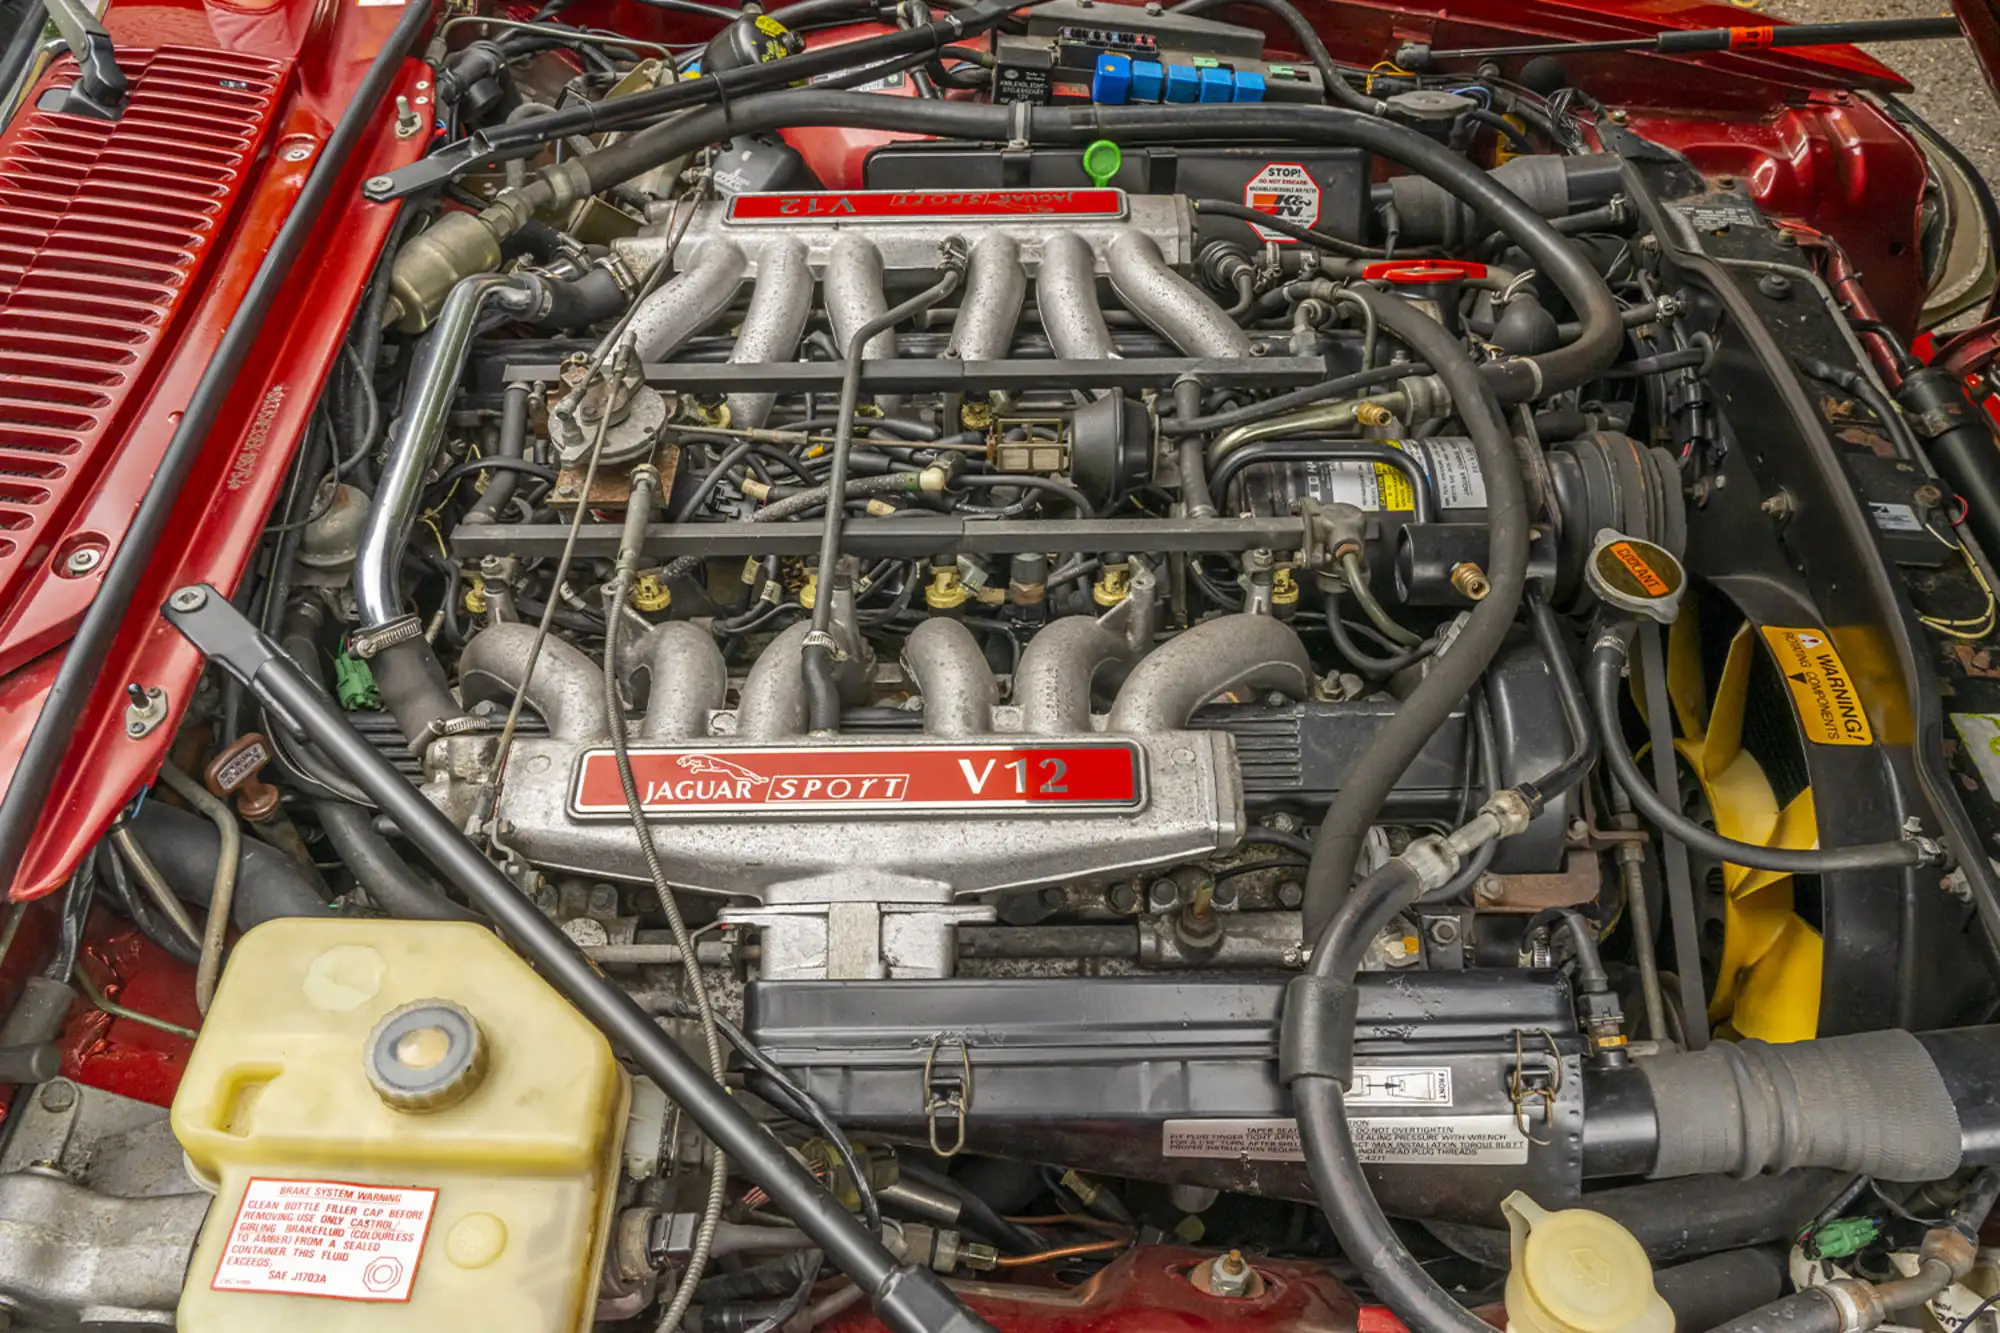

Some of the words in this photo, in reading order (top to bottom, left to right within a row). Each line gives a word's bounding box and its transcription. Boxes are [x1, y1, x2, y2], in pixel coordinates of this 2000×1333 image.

[1268, 168, 1301, 177] STOP!
[779, 197, 857, 214] V12
[1000, 192, 1072, 202] JAGUAR
[1616, 548, 1661, 587] COOLANT
[1783, 632, 1812, 668] ROTATING
[1805, 671, 1840, 740] COMPONENTS
[1816, 654, 1865, 741] WARNING!
[643, 780, 752, 805] JAGUAR
[957, 758, 1069, 795] V12
[1438, 1072, 1446, 1099] FRONT
[1459, 1141, 1492, 1149] TORQUE
[279, 1186, 309, 1197] BRAKE
[314, 1187, 354, 1200] SYSTEM
[357, 1191, 402, 1203] WARNING
[247, 1200, 280, 1210] CLEAN
[283, 1201, 320, 1212] BOTTLE
[325, 1203, 358, 1215] FILLER
[363, 1207, 384, 1217] CAP
[388, 1208, 425, 1220] BEFORE
[239, 1222, 277, 1233] GIRLING
[297, 1213, 315, 1223] USE
[320, 1214, 344, 1225] ONLY
[236, 1233, 249, 1242] TO
[294, 1235, 323, 1247] FROM
[328, 1239, 336, 1248] A
[343, 1240, 381, 1252] SEALED
[293, 1247, 315, 1258] THIS
[320, 1250, 349, 1262] FLUID
[291, 1272, 327, 1284] J1703A
